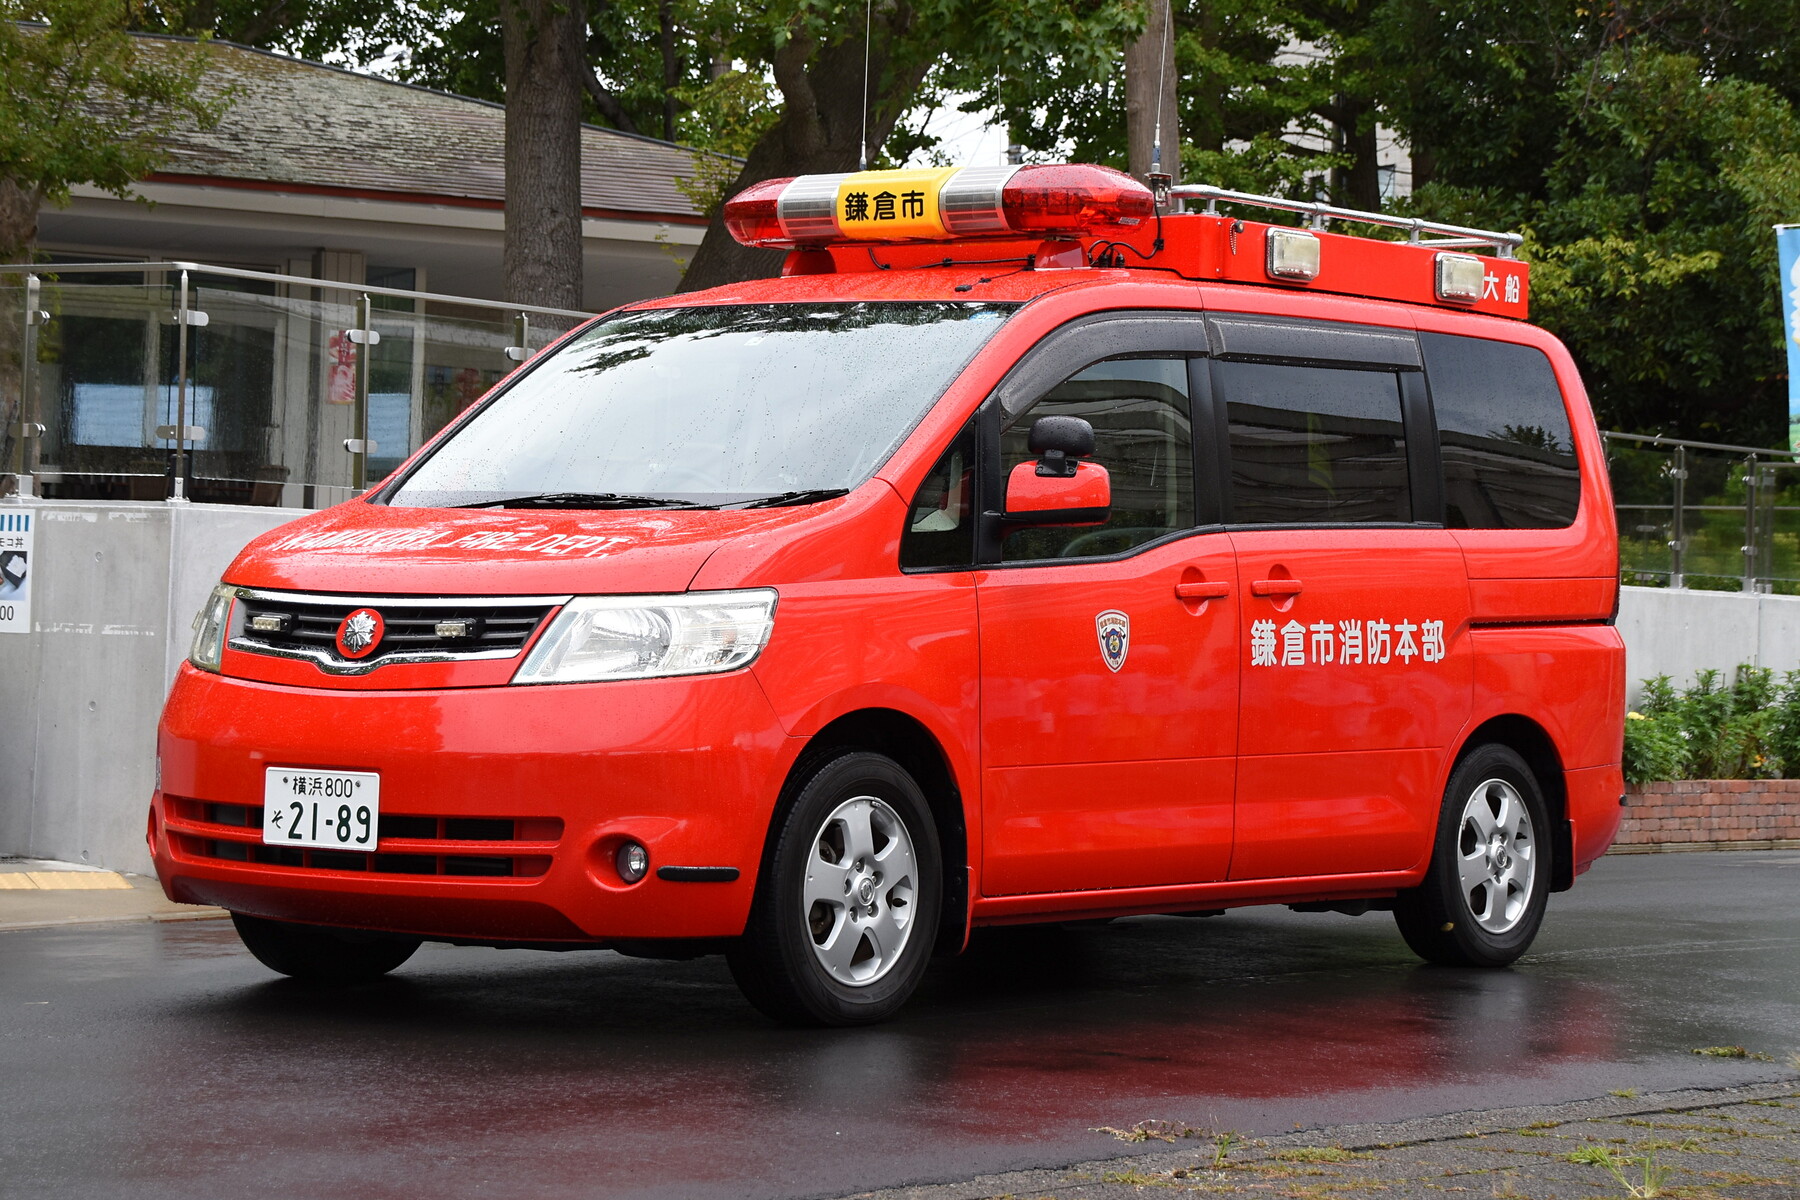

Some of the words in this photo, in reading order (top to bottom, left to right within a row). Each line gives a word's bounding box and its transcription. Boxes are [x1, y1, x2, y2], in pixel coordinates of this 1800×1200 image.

[845, 190, 925, 221] 鎌倉市
[1483, 271, 1520, 303] 大船
[442, 531, 535, 551] FIRE
[1250, 618, 1446, 667] 鎌倉市消防本部
[271, 810, 283, 829] そ
[288, 801, 371, 843] 21-89
